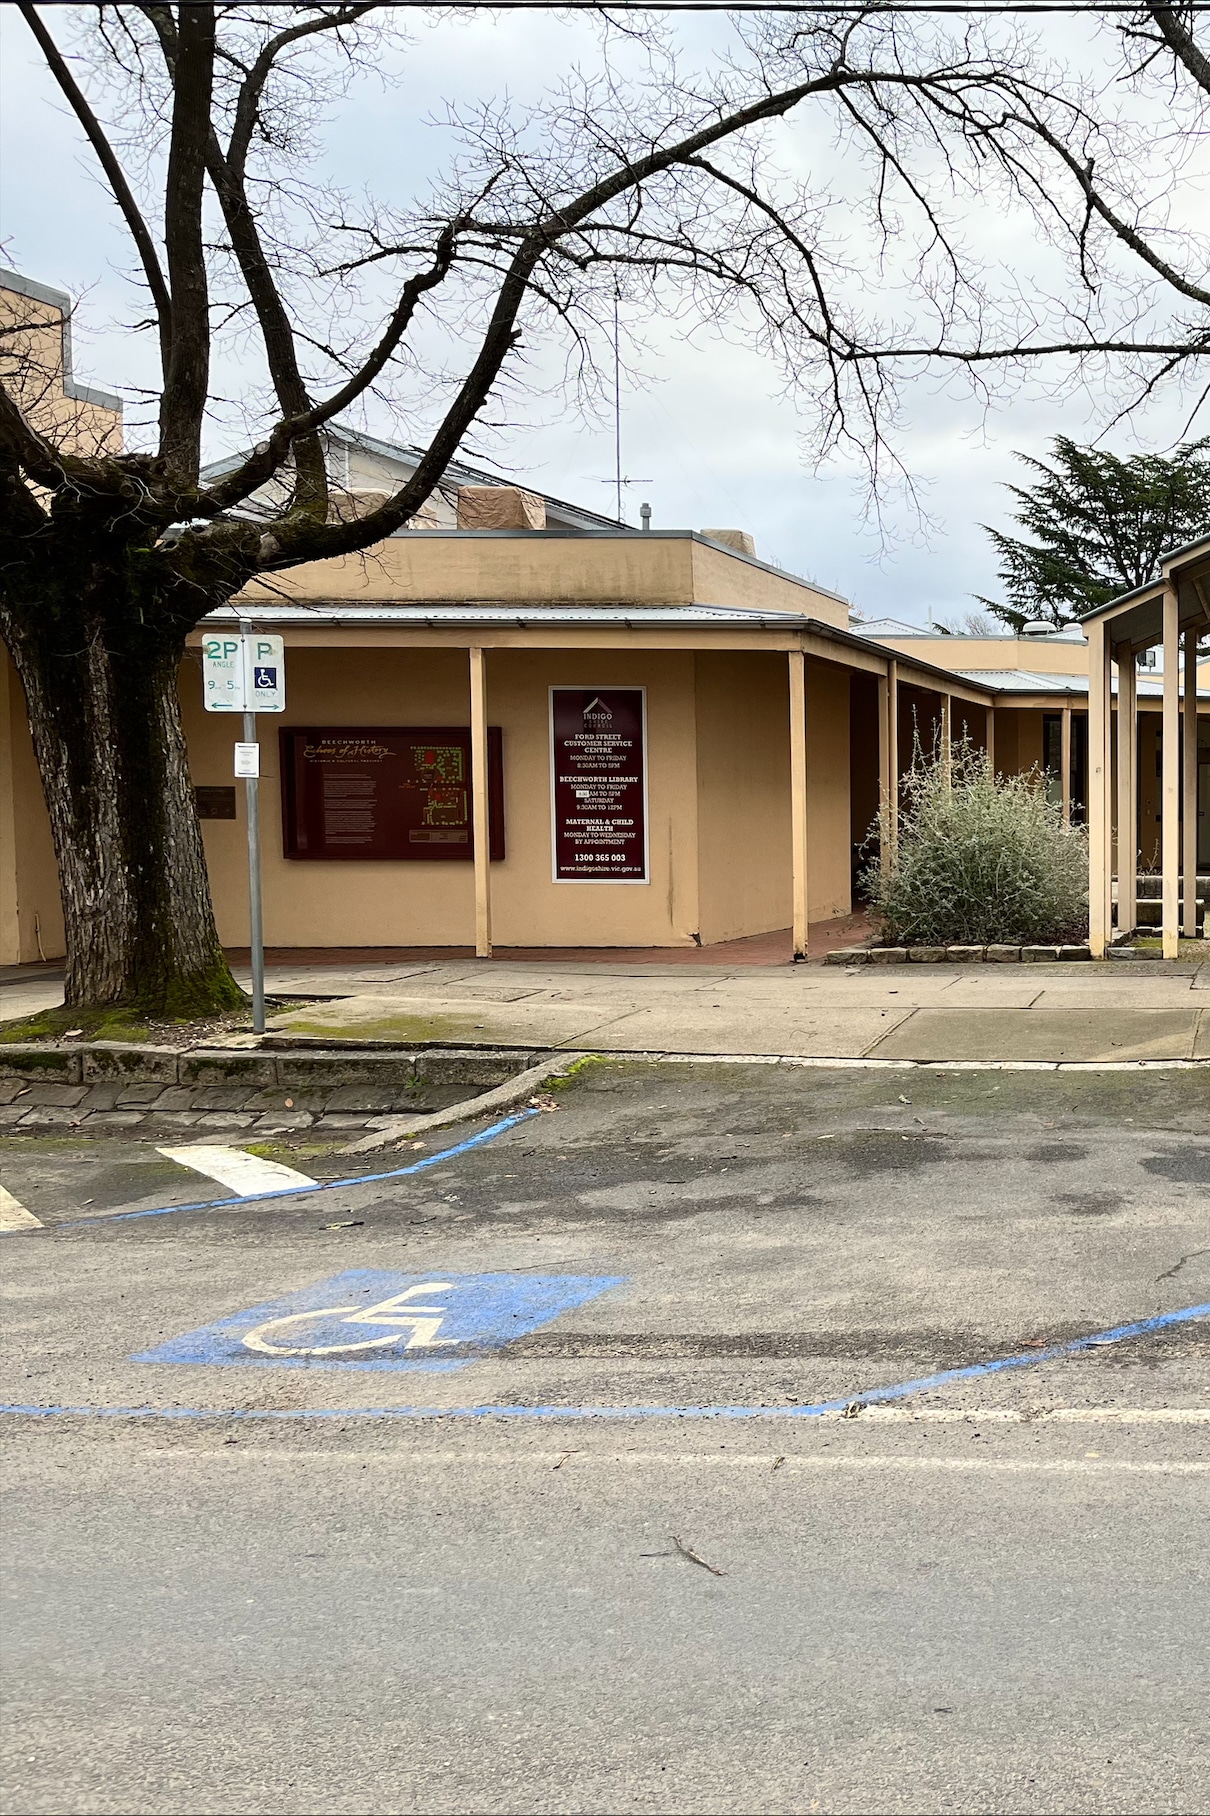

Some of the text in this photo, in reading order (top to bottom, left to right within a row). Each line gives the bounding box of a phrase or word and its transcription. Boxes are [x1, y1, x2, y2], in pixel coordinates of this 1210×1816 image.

[207, 641, 239, 660] 2P
[257, 642, 273, 660] P
[213, 661, 235, 669] ANGLE
[255, 690, 276, 698] ONLY
[303, 745, 397, 759] Echoes of History
[575, 854, 626, 862] 1300 365 003
[560, 865, 642, 873] www.indigoshire.vic.gov.au
